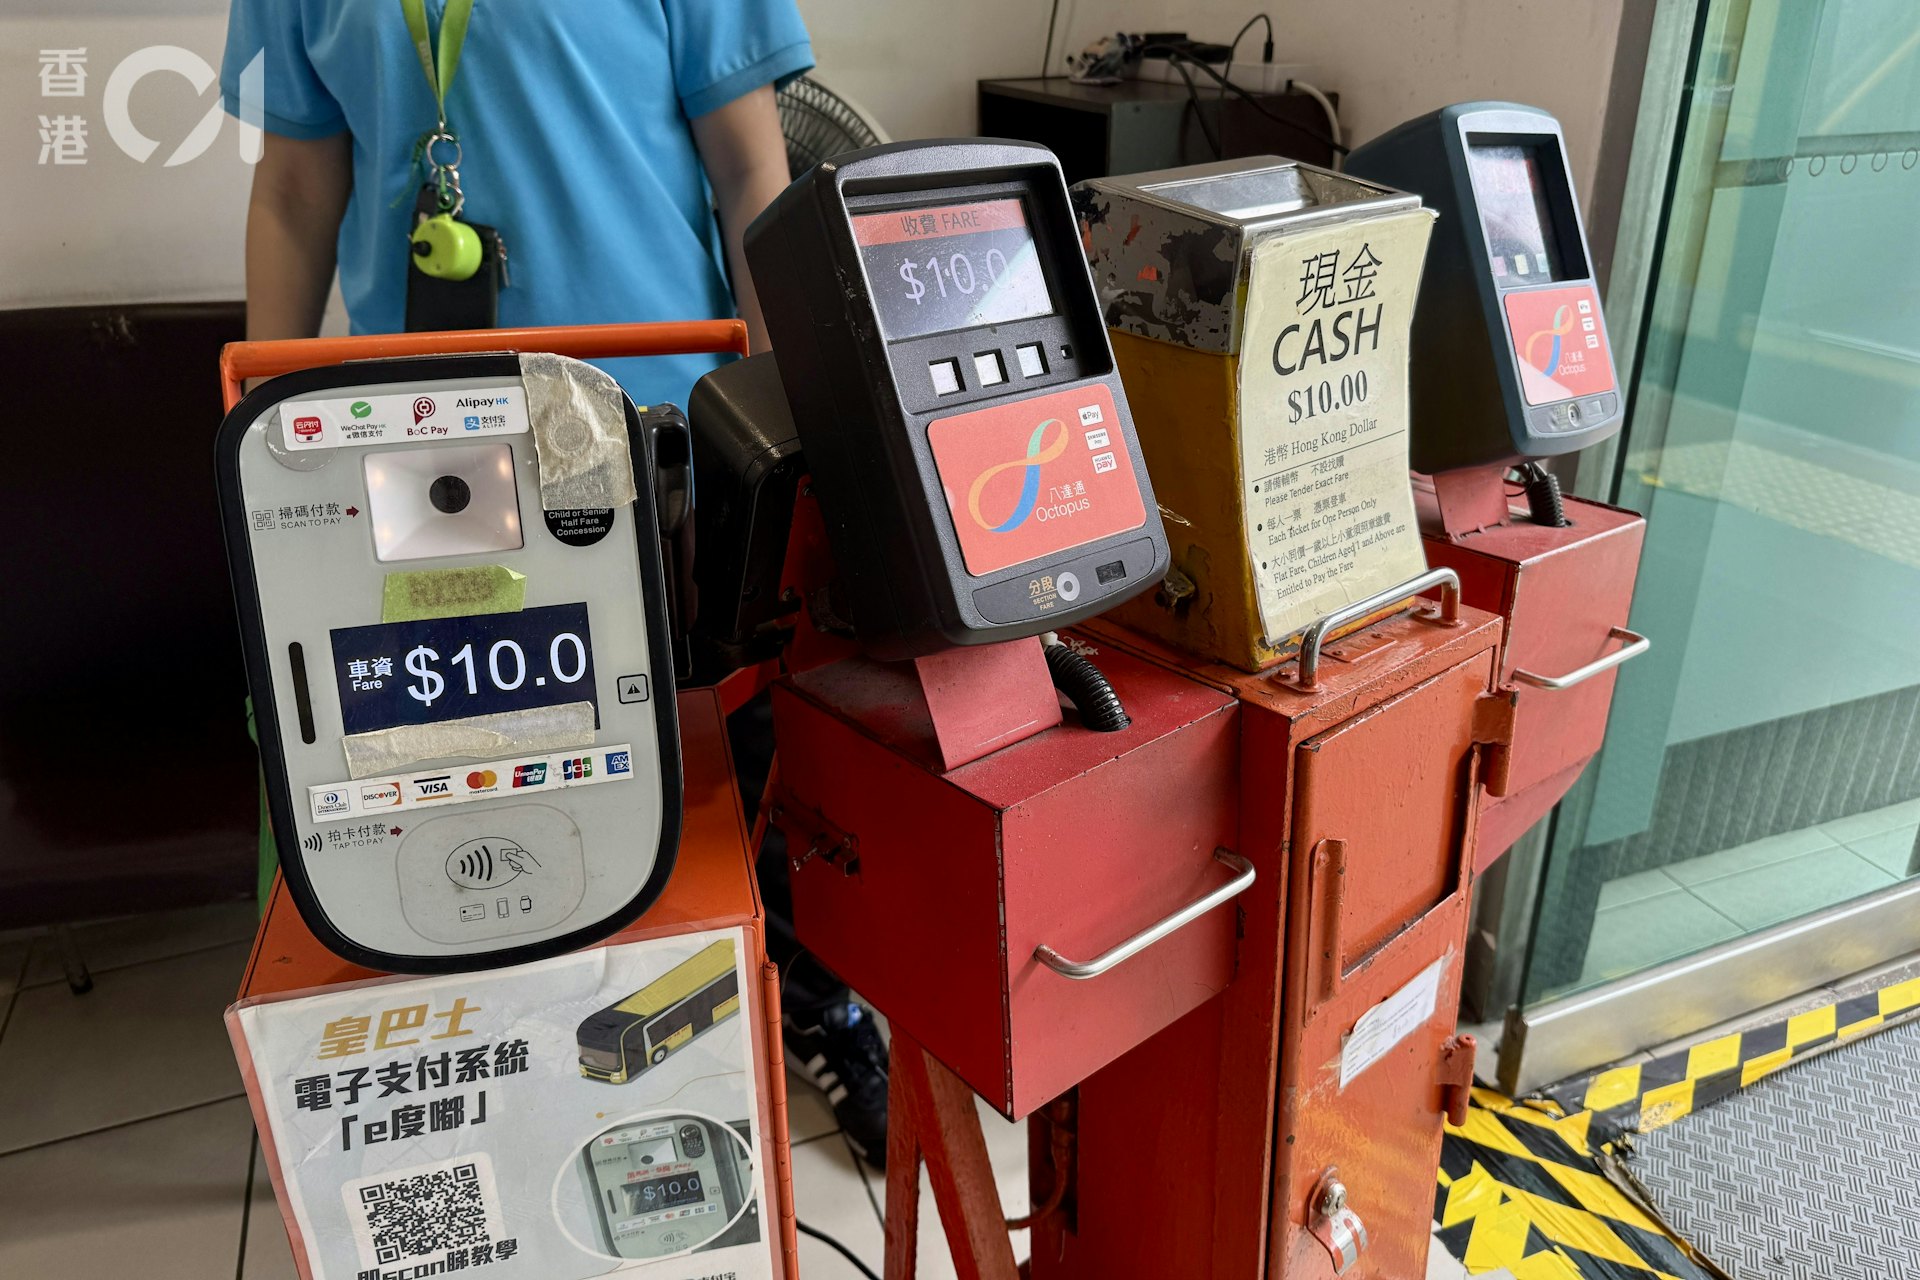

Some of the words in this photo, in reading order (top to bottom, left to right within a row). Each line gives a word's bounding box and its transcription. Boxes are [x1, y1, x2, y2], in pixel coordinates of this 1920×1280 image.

[900, 214, 938, 237] 收費
[941, 211, 981, 230] FARE
[899, 248, 1010, 305] $10.0
[1296, 242, 1383, 316] 現金
[1272, 303, 1384, 376] CASH
[1288, 370, 1368, 425] $10.00
[431, 426, 449, 435] Pay
[1264, 443, 1289, 466] 港幣
[1291, 437, 1319, 457] Hong
[1321, 428, 1347, 446] Kong
[1349, 418, 1378, 437] Dollar
[1096, 459, 1113, 471] pay
[1049, 480, 1087, 503] 八達通
[1265, 493, 1288, 508] Please
[1289, 483, 1314, 499] Tender
[1315, 476, 1333, 490] Exact
[1334, 472, 1349, 483] Fare
[278, 502, 341, 520] 掃碼付款
[548, 510, 571, 519] Child
[582, 508, 609, 516] Senior
[1036, 498, 1091, 522] Octopus
[1266, 508, 1302, 530] 每人一票
[281, 520, 307, 529] SCAN
[307, 519, 322, 527] TO
[323, 517, 342, 525] PAY
[556, 526, 606, 537] Concession
[560, 518, 578, 527] Half
[580, 517, 600, 526] Fare
[1268, 531, 1287, 545] Each
[1287, 523, 1310, 538] Ticket
[1311, 519, 1321, 530] for
[1322, 514, 1337, 525] One
[1338, 506, 1360, 520] Person
[1361, 498, 1377, 510] Only
[1273, 571, 1288, 584] Flat
[1289, 565, 1307, 578] Fare,
[1307, 552, 1337, 570] Children
[1338, 542, 1355, 558] Aged
[1362, 534, 1374, 548] and
[1375, 531, 1395, 543] Above
[1396, 524, 1406, 534] are
[1029, 576, 1055, 596] 分段
[1277, 582, 1305, 600] Entitled
[1305, 579, 1312, 588] to
[1313, 573, 1326, 585] Pay
[1327, 567, 1338, 579] the
[1339, 561, 1354, 574] Fare
[1032, 593, 1057, 605] SECTION
[1039, 601, 1055, 611] FARE
[347, 656, 394, 681] 車資
[404, 632, 587, 707] $10.0
[352, 679, 383, 692] Fare
[563, 763, 592, 774] JCB
[611, 755, 628, 765] AM
[614, 762, 629, 771] EX
[514, 768, 546, 778] UnionPay
[363, 791, 398, 801] DISCOVER
[420, 782, 449, 795] VISA
[327, 822, 387, 843] 拍卡付款
[333, 842, 350, 850] TAP
[351, 840, 365, 848] TO
[366, 837, 384, 846] PAY
[317, 997, 482, 1060] 皇巴士
[294, 1038, 529, 1112] 電子支付系統
[643, 1177, 700, 1201] $10.0
